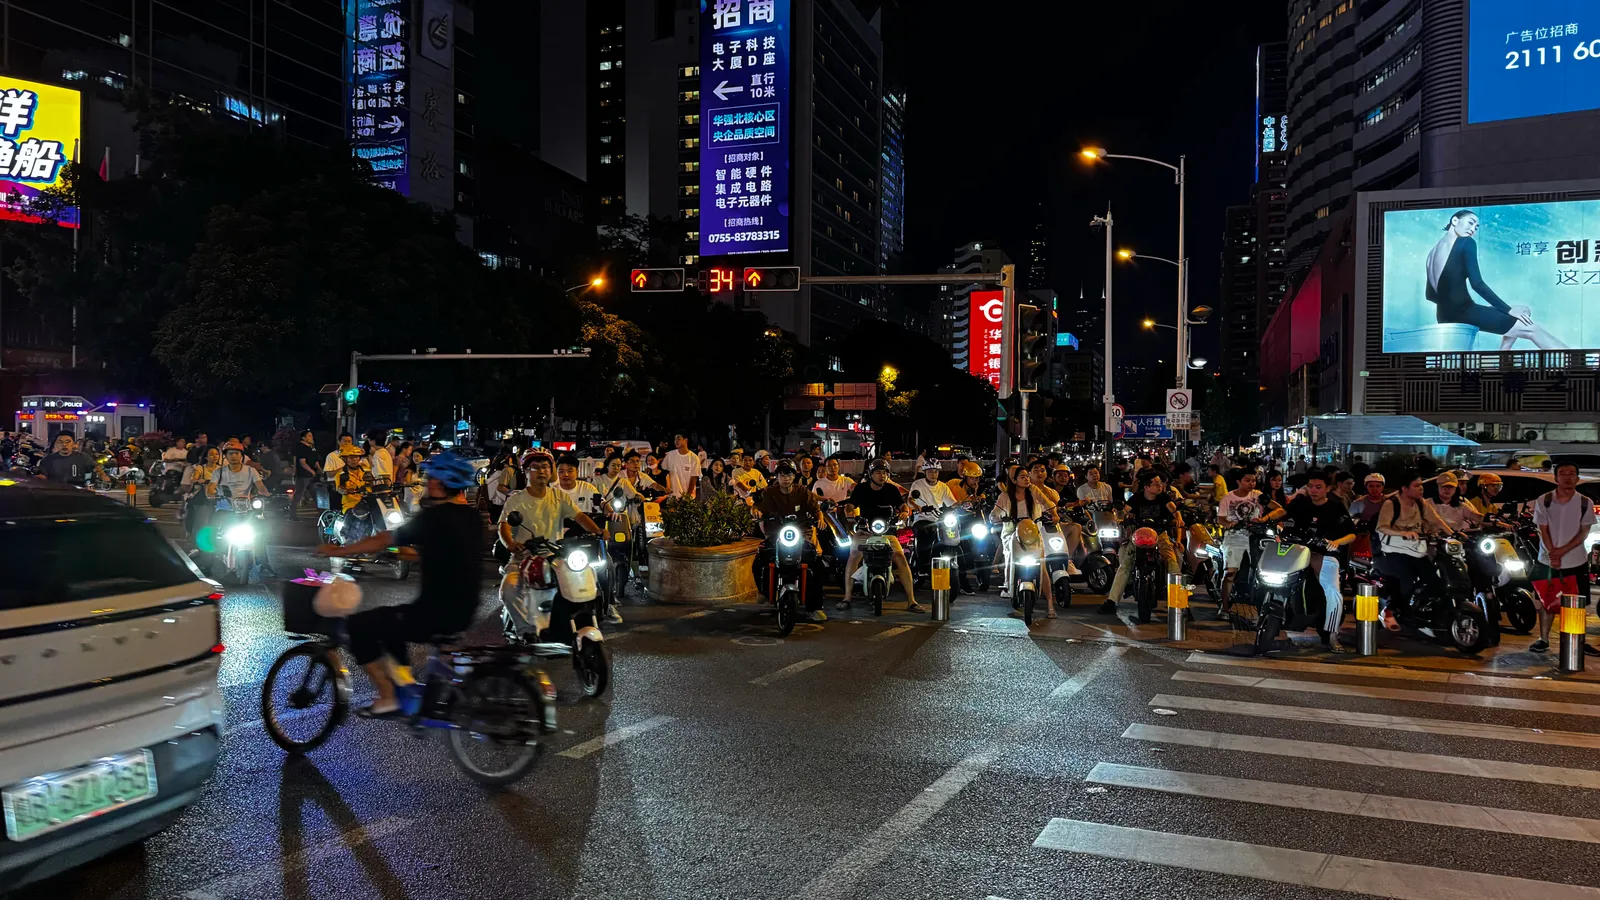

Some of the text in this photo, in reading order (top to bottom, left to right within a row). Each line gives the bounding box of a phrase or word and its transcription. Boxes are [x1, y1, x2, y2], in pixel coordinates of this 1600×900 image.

[713, 0, 775, 29] 招商
[1505, 23, 1579, 44] 广告位招商
[712, 36, 776, 56] 电子科技
[712, 52, 776, 71] 大厦D座
[1505, 45, 1561, 69] 2111
[751, 73, 775, 85] 直行
[750, 86, 776, 98] 10米
[713, 110, 775, 127] 华强北核心区
[713, 126, 775, 142] 央企品质空间
[0, 138, 61, 179] 船
[715, 165, 773, 180] 智能硬件
[715, 180, 773, 195] 集成电路
[715, 194, 773, 209] 电子元器件
[708, 230, 780, 244] 0755-83783315
[1516, 238, 1600, 264] 增享 创
[710, 269, 733, 292] 34
